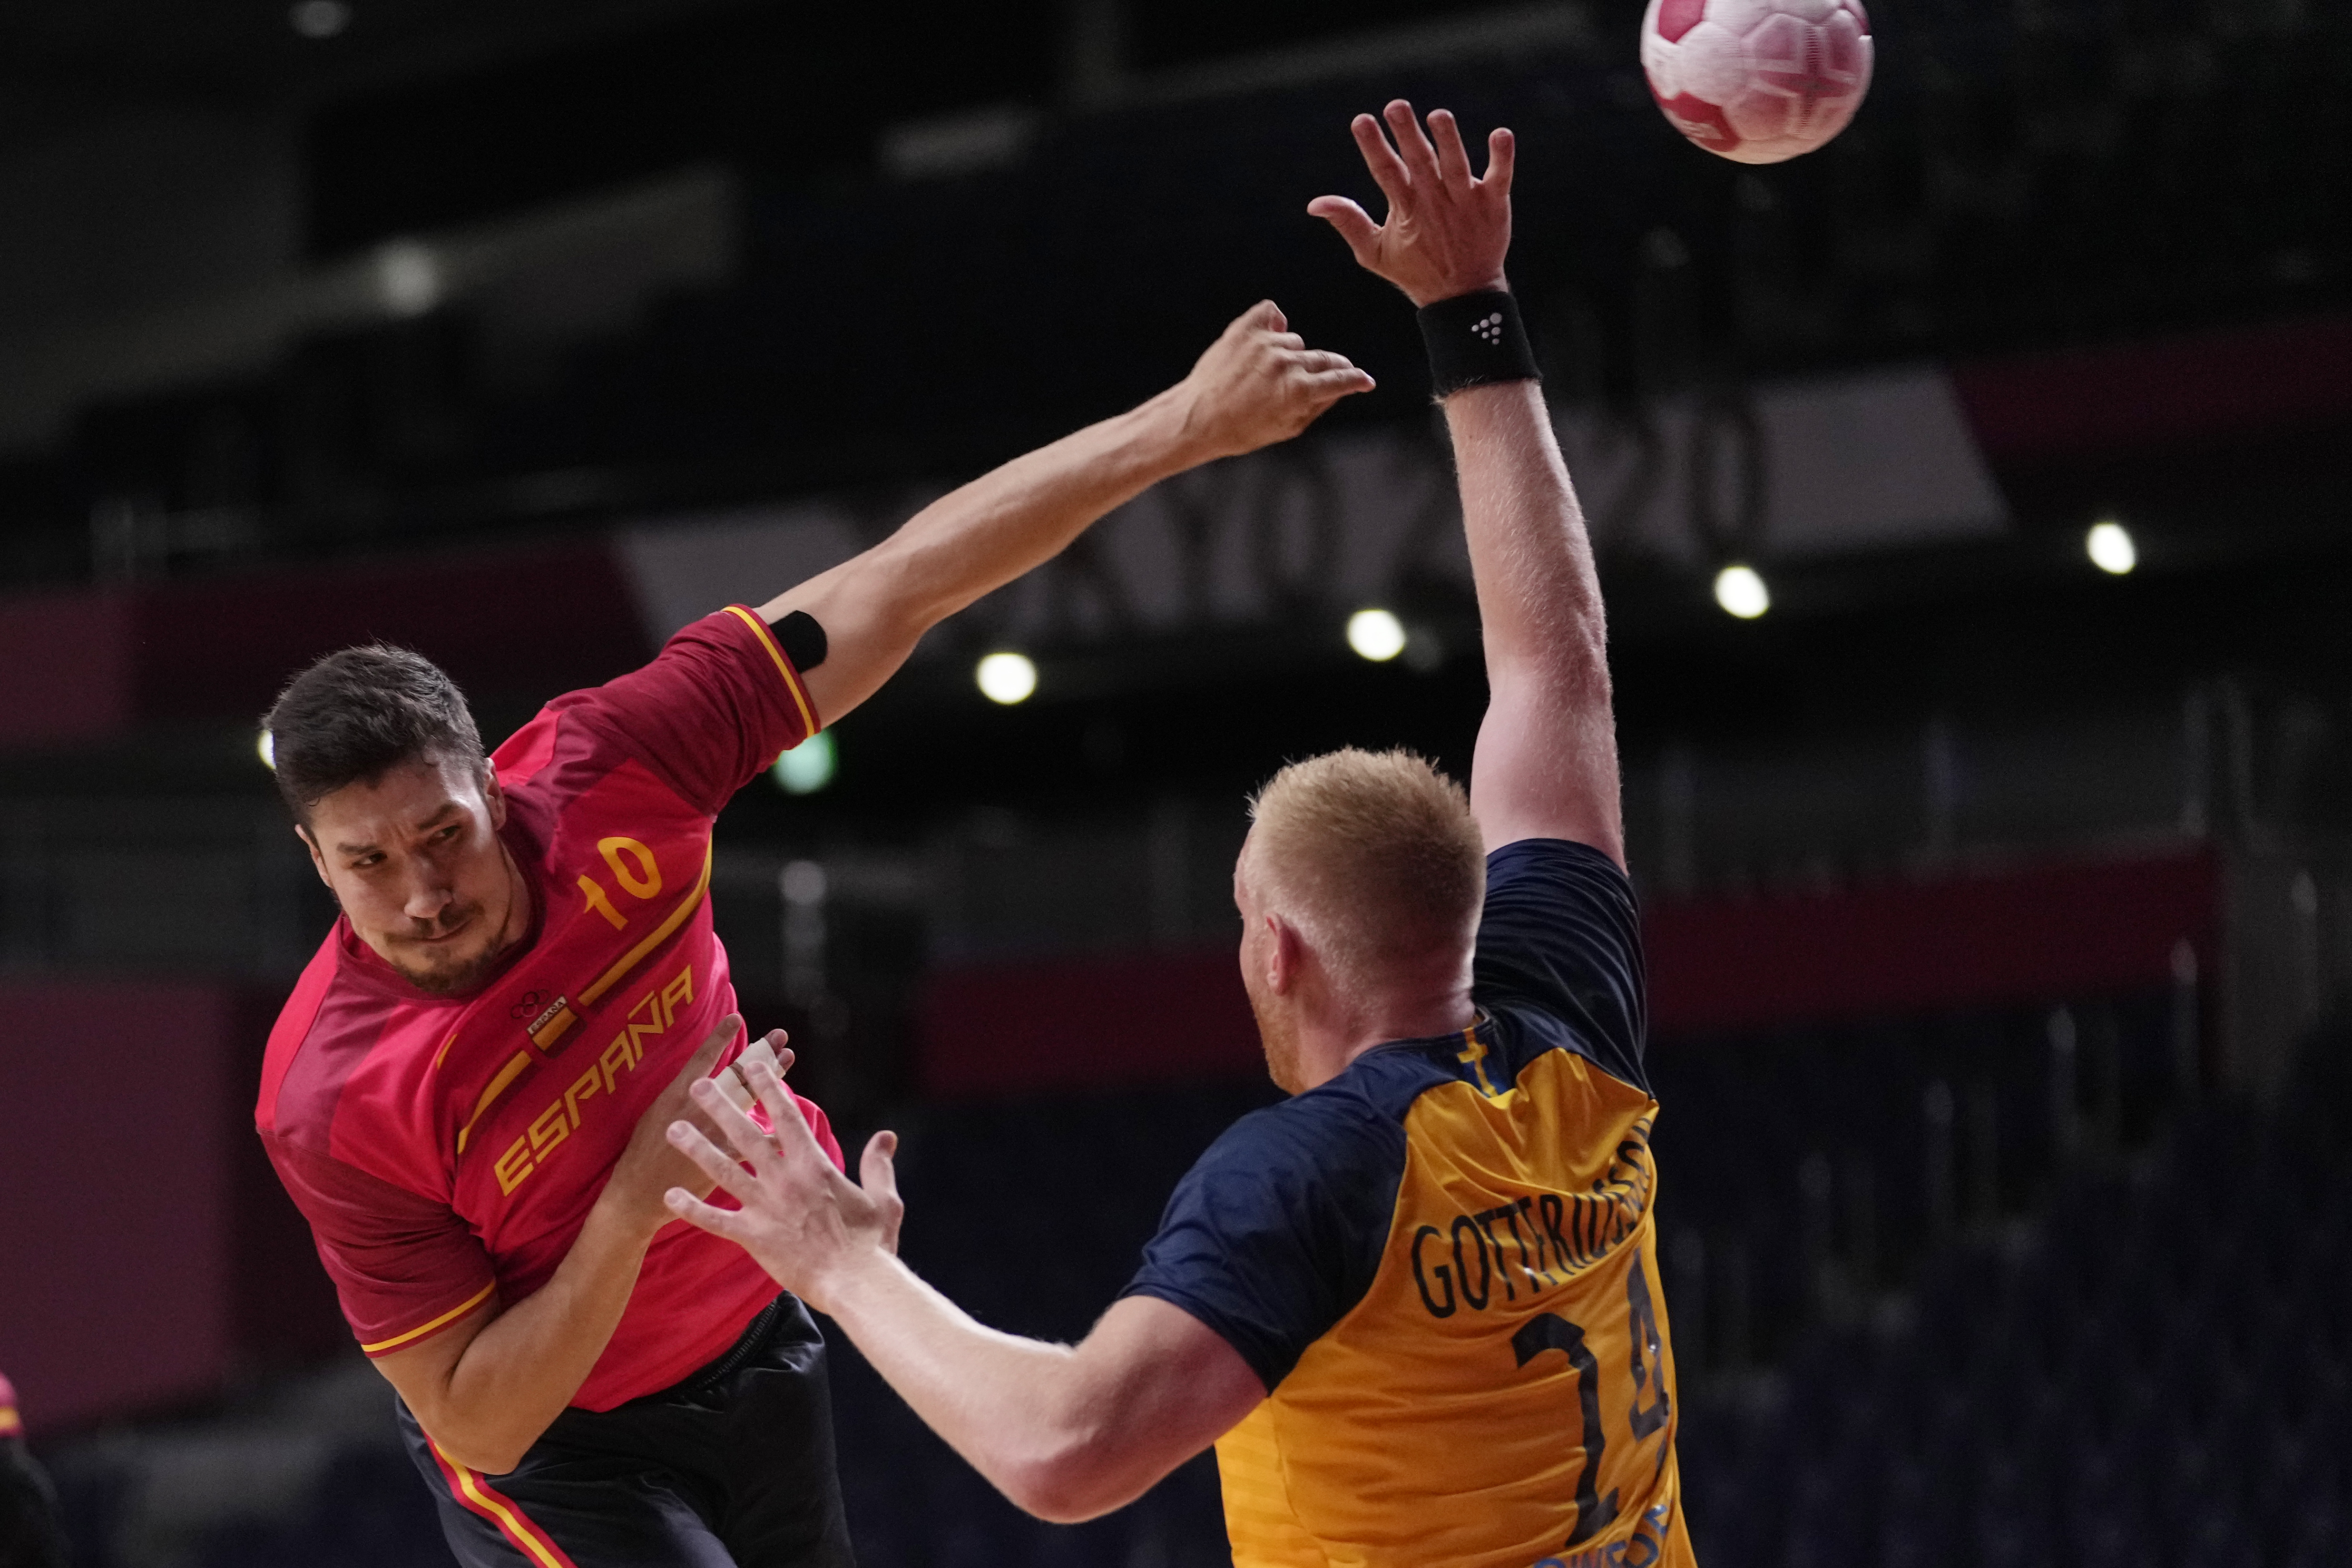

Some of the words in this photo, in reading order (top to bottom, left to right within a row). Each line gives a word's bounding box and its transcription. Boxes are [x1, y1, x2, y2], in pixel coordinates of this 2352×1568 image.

[577, 836, 663, 931] 10
[493, 964, 694, 1197] ESPAÑA
[1511, 1246, 1671, 1548] 24
